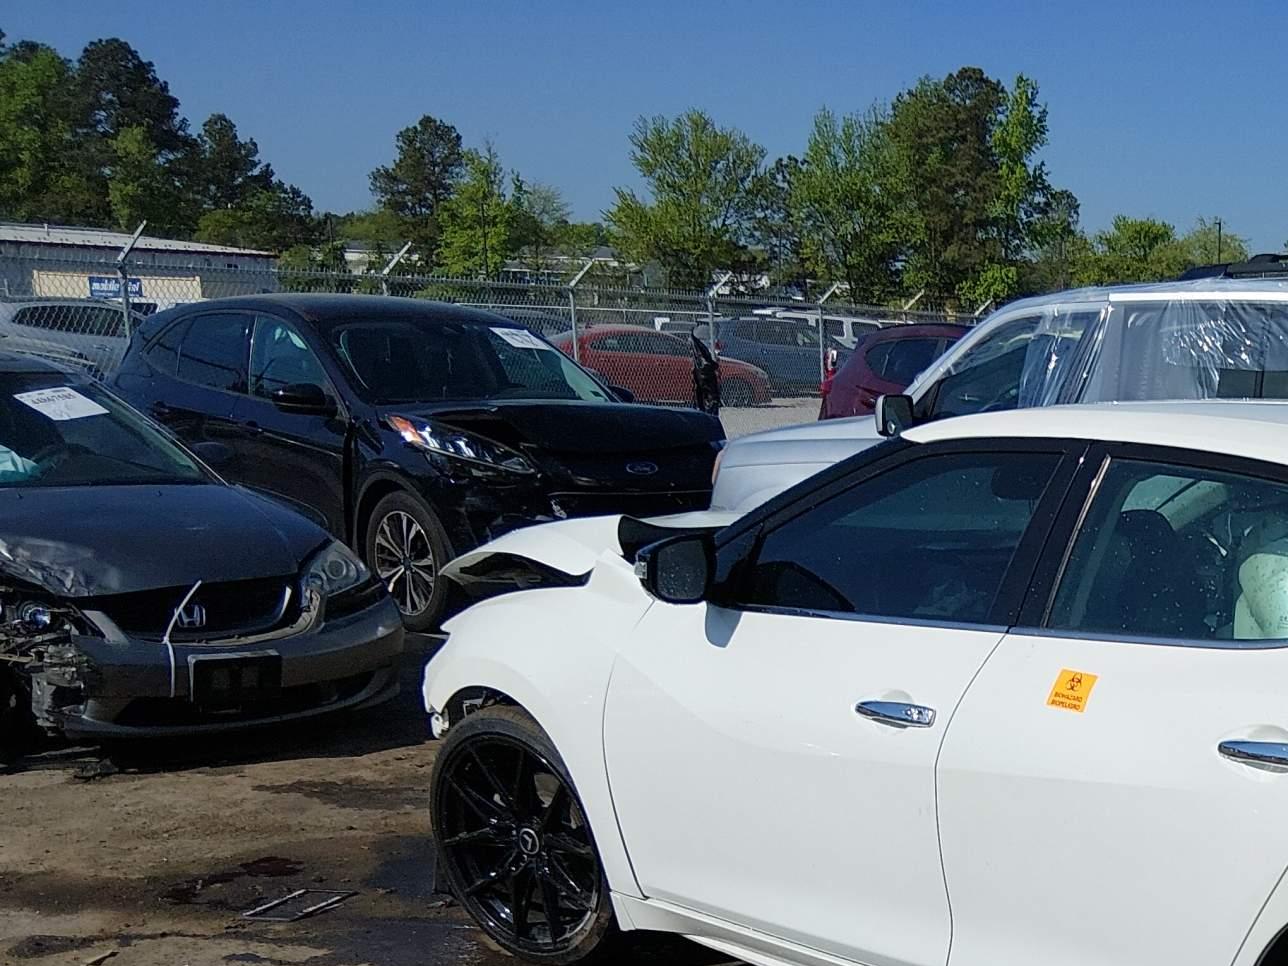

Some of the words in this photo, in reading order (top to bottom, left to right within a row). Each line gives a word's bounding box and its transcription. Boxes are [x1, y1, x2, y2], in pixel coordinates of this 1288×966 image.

[92, 279, 120, 291] mobile
[1053, 691, 1083, 703] BIOHAZARD
[1050, 698, 1081, 711] BIOPELIGRO
